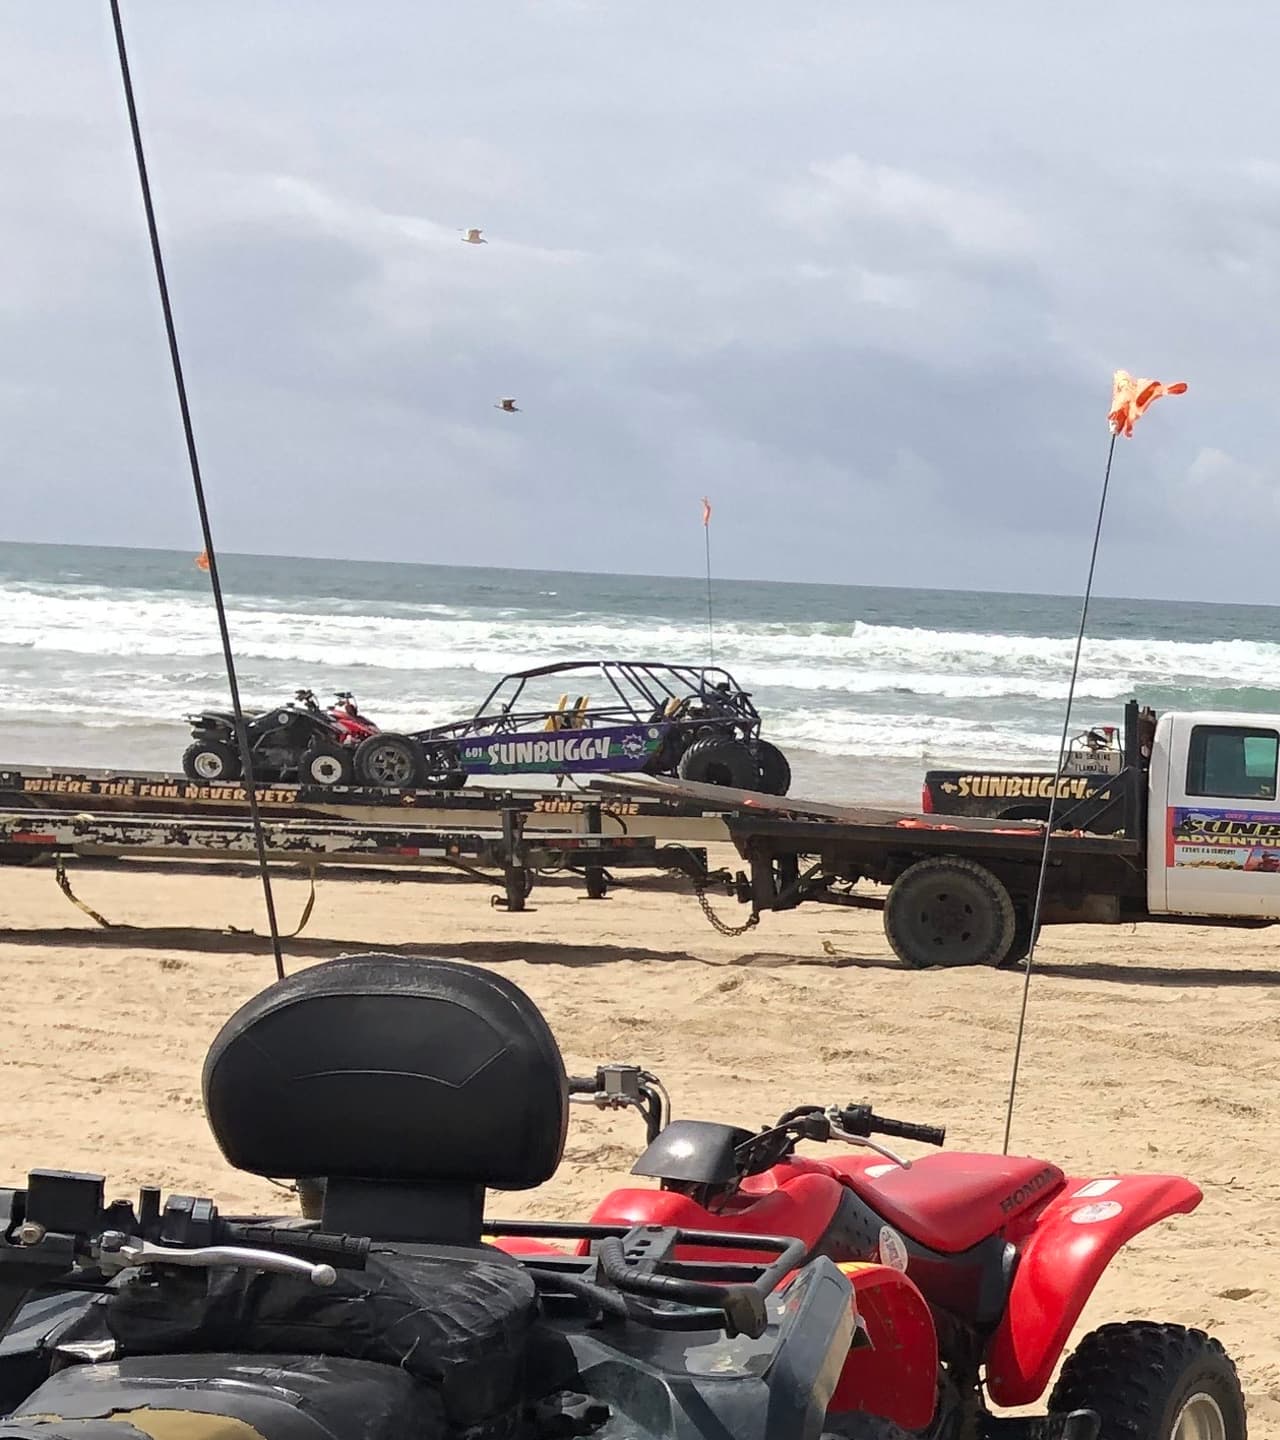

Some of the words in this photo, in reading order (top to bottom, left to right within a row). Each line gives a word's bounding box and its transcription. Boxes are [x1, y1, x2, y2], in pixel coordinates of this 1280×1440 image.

[465, 747, 482, 758] 601
[488, 736, 611, 766] SUNBUGGY
[23, 778, 93, 793] WHERE
[99, 783, 134, 796] THE
[139, 783, 180, 797] FUN
[184, 784, 247, 801] NEVER
[254, 789, 298, 803] SETS
[533, 800, 640, 815] SUNBGIE
[1000, 1167, 1056, 1214] HONDA
